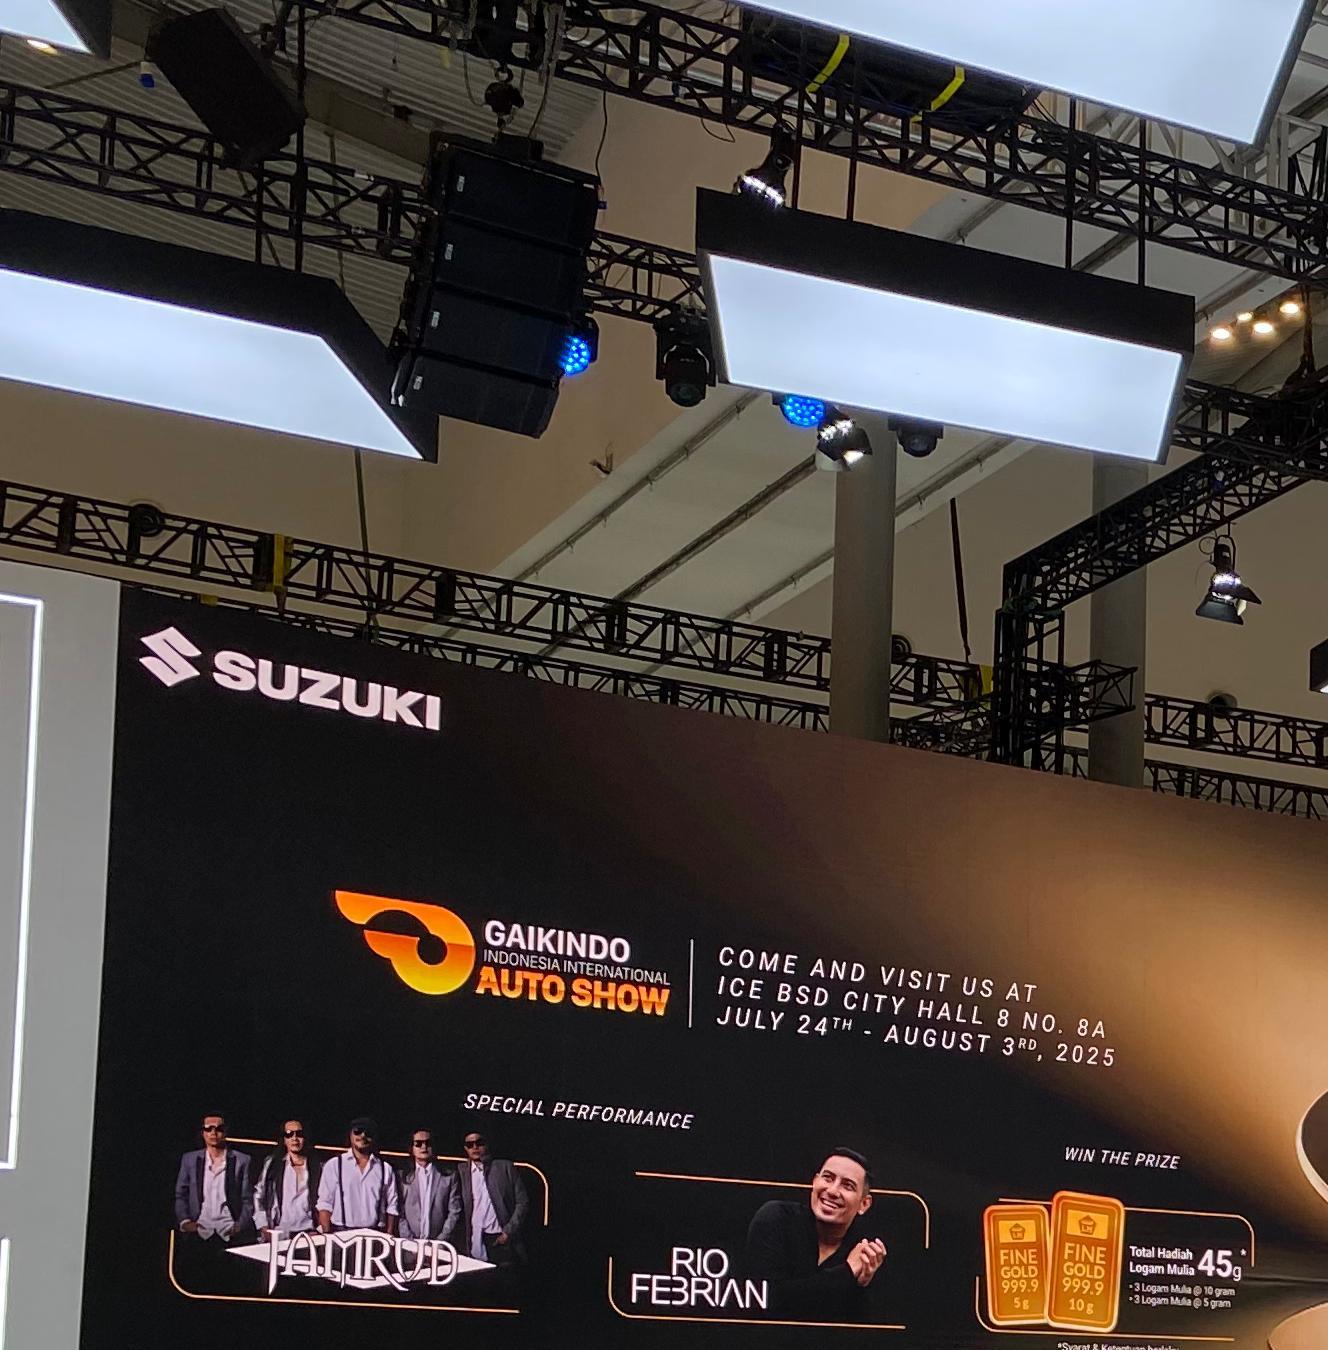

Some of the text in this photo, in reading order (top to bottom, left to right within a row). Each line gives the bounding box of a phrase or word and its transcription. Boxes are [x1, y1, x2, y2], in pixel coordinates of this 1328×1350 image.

[212, 650, 441, 731] SUZUKI
[484, 920, 630, 963] GAIKINDO
[484, 949, 671, 986] INDONESIA INTERNATIONAL
[719, 946, 1037, 1003] COME AND VISIT US AT
[476, 966, 671, 1016] AUTO SHOW
[717, 976, 1106, 1039] ICE BSD CITY HALL 8 NO. 8A
[717, 1006, 784, 1031] JULY
[797, 1014, 854, 1036] 24TH
[884, 1025, 991, 1053] AUGUST
[1056, 1043, 1115, 1067] 2025
[464, 1093, 694, 1129] SPECIAL PERFORMANCE
[1065, 1146, 1181, 1170] WIN THE PRIZE
[672, 1247, 729, 1278] RIO
[1000, 1249, 1038, 1265] FINE
[1064, 1242, 1107, 1264] FINE
[1129, 1246, 1193, 1260] Total Hadiah
[1001, 1265, 1038, 1279] GOLD
[1063, 1262, 1105, 1279] GOLD
[1129, 1261, 1195, 1276] Logam Mulia
[631, 1273, 767, 1309] FEBRIAN
[1002, 1279, 1039, 1294] 999.9
[1062, 1277, 1104, 1296] 999.9
[1134, 1282, 1140, 1292] 3
[1142, 1283, 1169, 1294] Logam
[1170, 1284, 1192, 1294] Mulia
[1204, 1286, 1213, 1295] 10
[1215, 1287, 1235, 1297] gram
[1013, 1297, 1021, 1309] 5
[1069, 1298, 1085, 1312] 10
[1134, 1294, 1140, 1304] 3
[1142, 1295, 1169, 1307] Logam
[1170, 1296, 1192, 1306] Mulia
[1203, 1298, 1209, 1307] 5
[1210, 1299, 1231, 1310] gram
